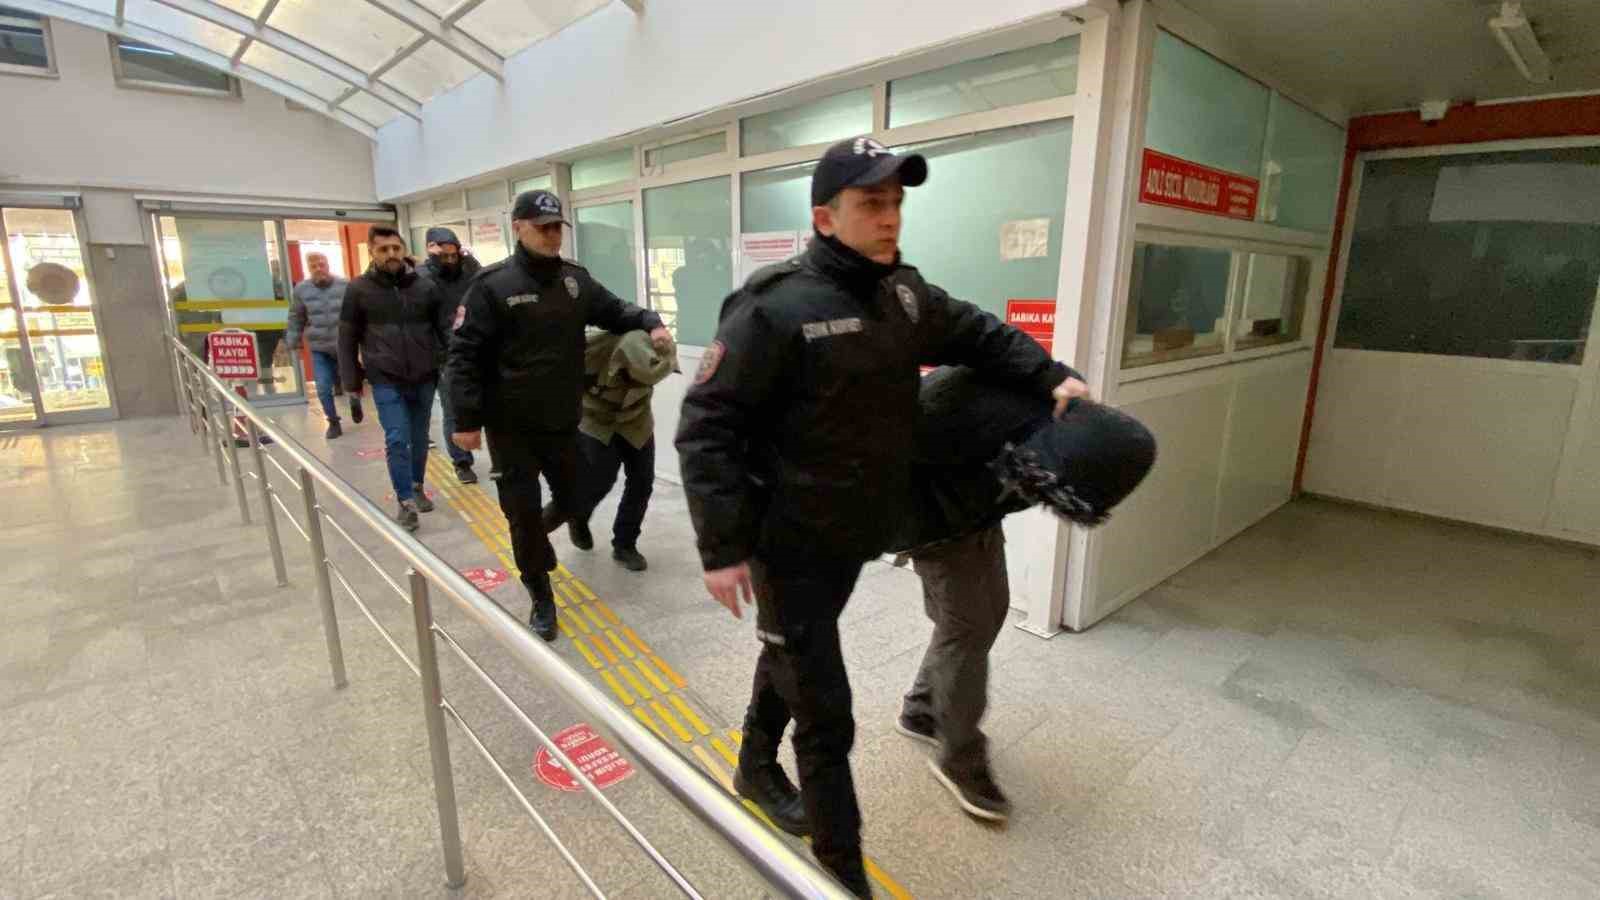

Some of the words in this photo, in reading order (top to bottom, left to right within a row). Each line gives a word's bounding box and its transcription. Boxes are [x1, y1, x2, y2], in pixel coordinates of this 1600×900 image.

[1011, 312, 1040, 323] SABIKA
[1042, 312, 1056, 323] KA
[213, 336, 249, 346] SABIKA
[218, 347, 248, 358] KAYDI
